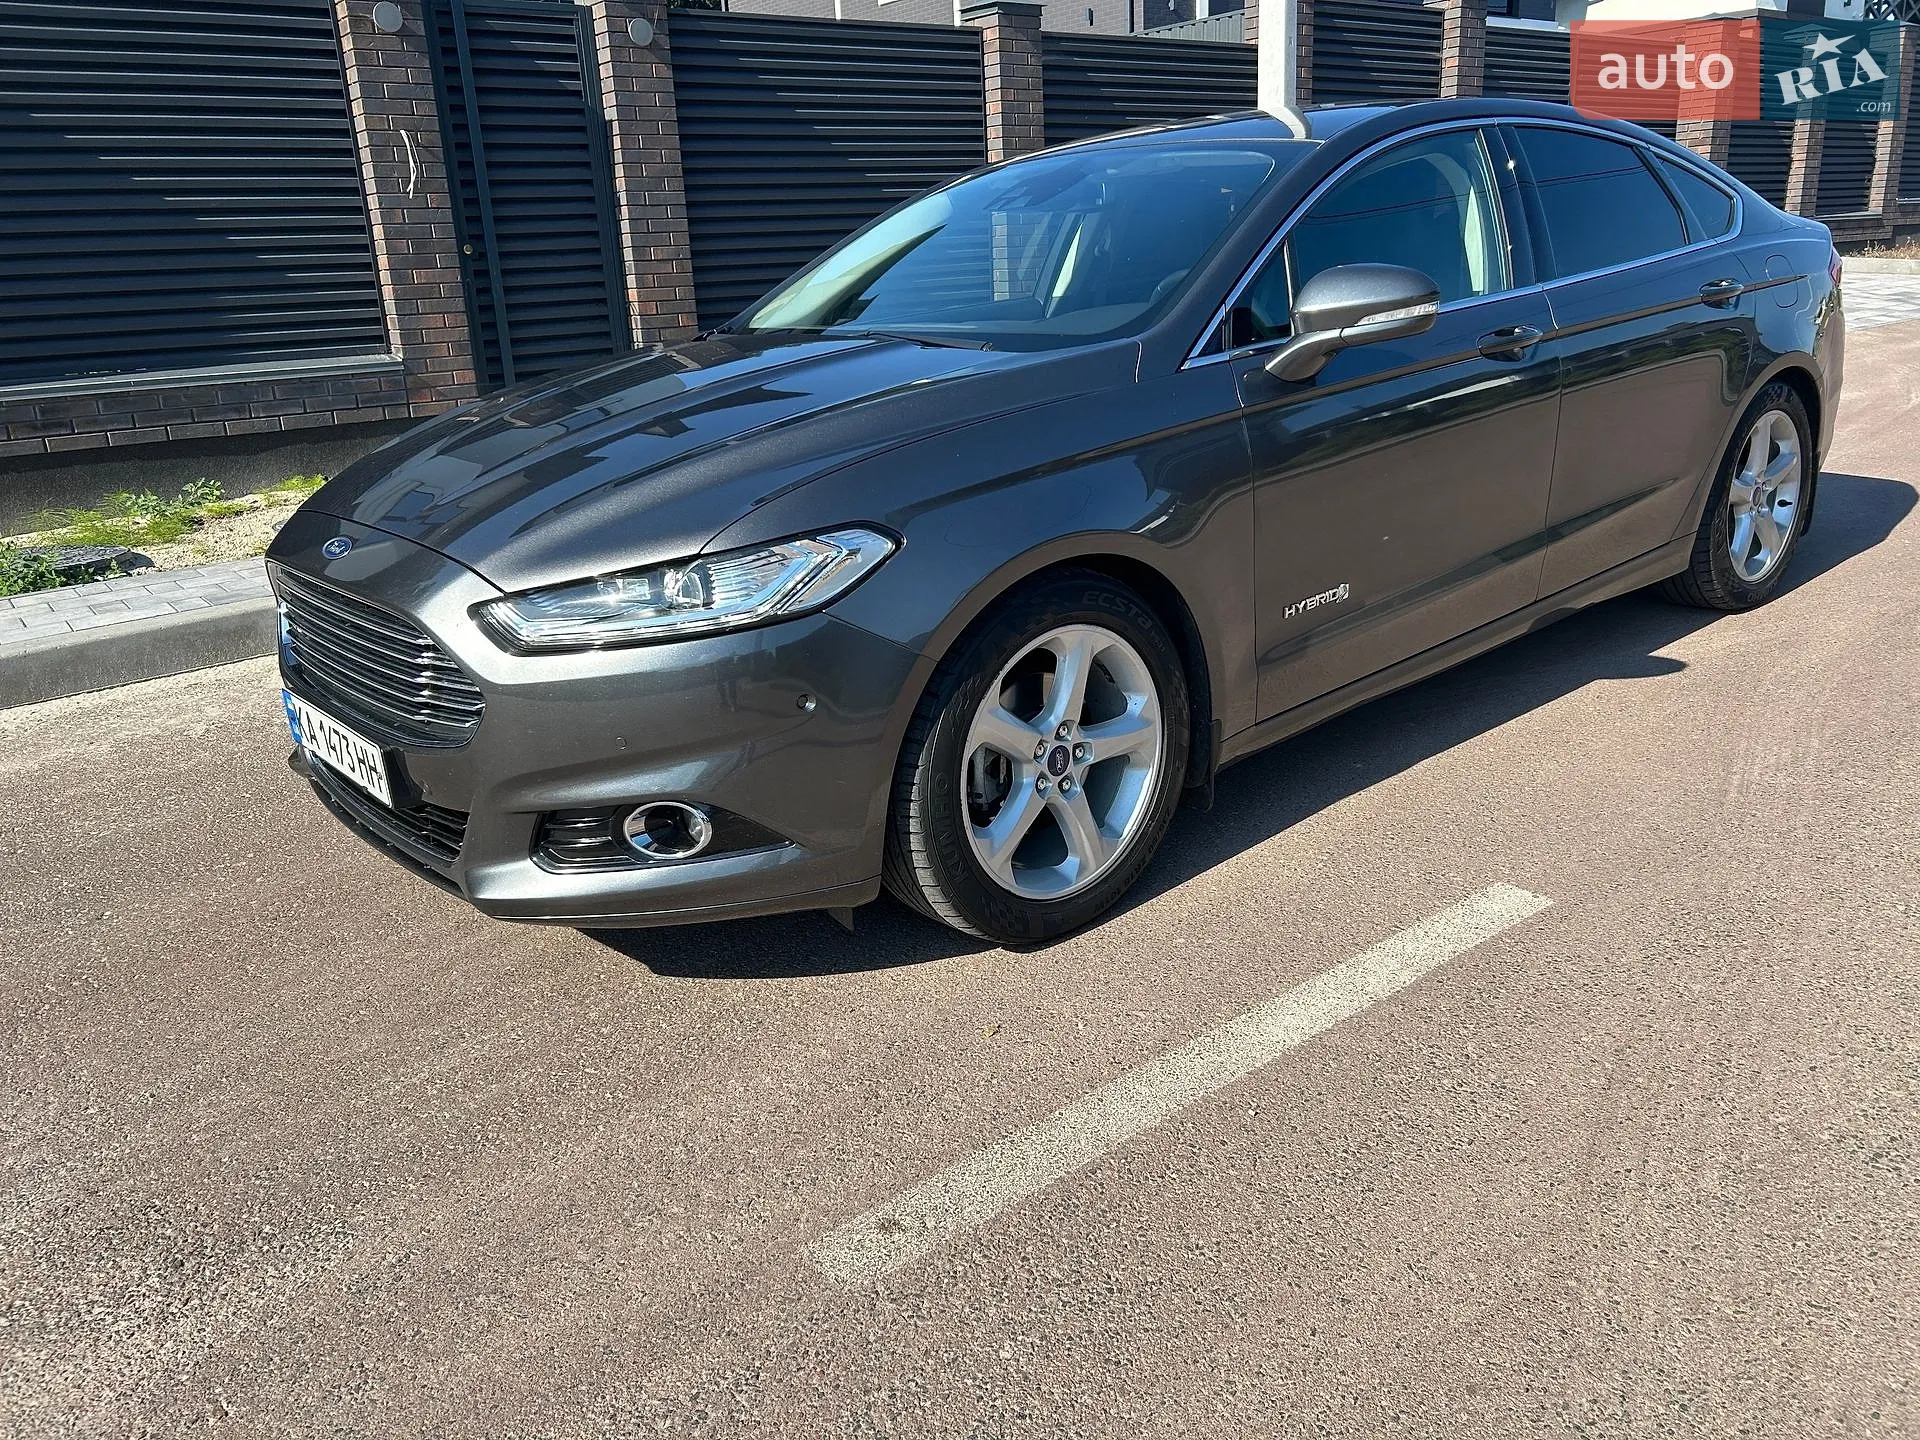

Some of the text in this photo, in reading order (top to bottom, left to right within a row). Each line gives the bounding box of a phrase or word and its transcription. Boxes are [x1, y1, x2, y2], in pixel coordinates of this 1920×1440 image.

[1283, 588, 1341, 619] HYBRID
[291, 702, 383, 793] KA 1473 HH
